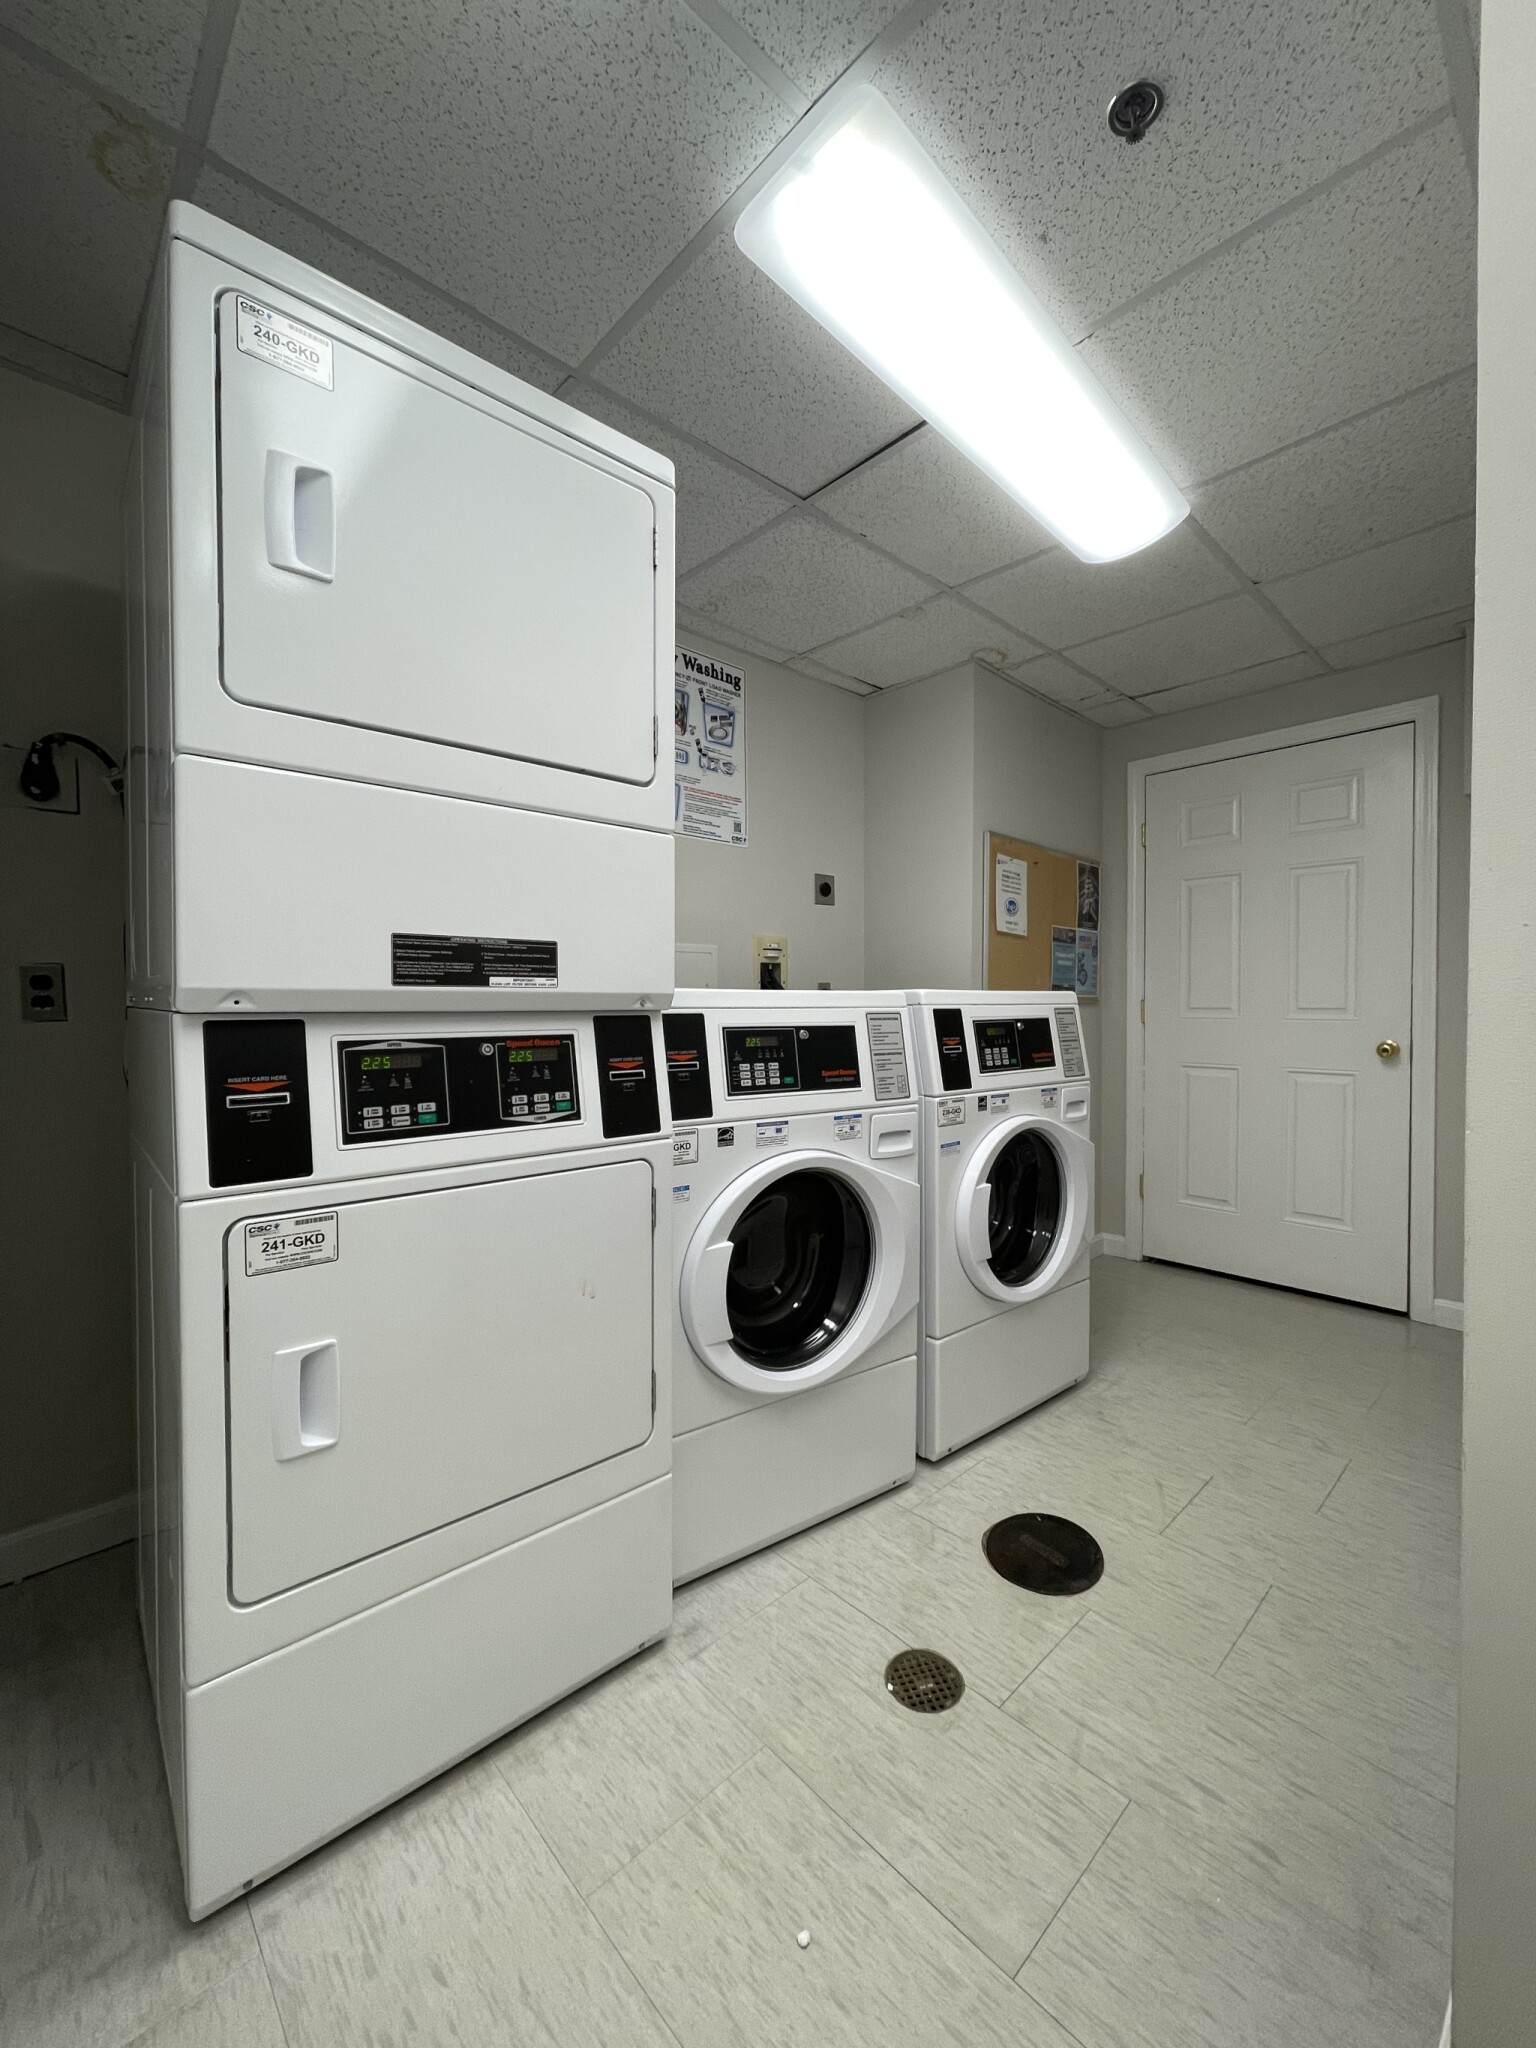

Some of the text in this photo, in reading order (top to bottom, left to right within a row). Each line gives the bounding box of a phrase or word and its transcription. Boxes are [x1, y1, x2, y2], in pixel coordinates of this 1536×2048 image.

[240, 301, 265, 317] CSC
[253, 325, 320, 364] 240-GKD
[681, 652, 742, 691] Washing
[506, 1039, 561, 1049] Speed Queen
[248, 1224, 273, 1234] CSC
[260, 1232, 325, 1253] 241-GKD
